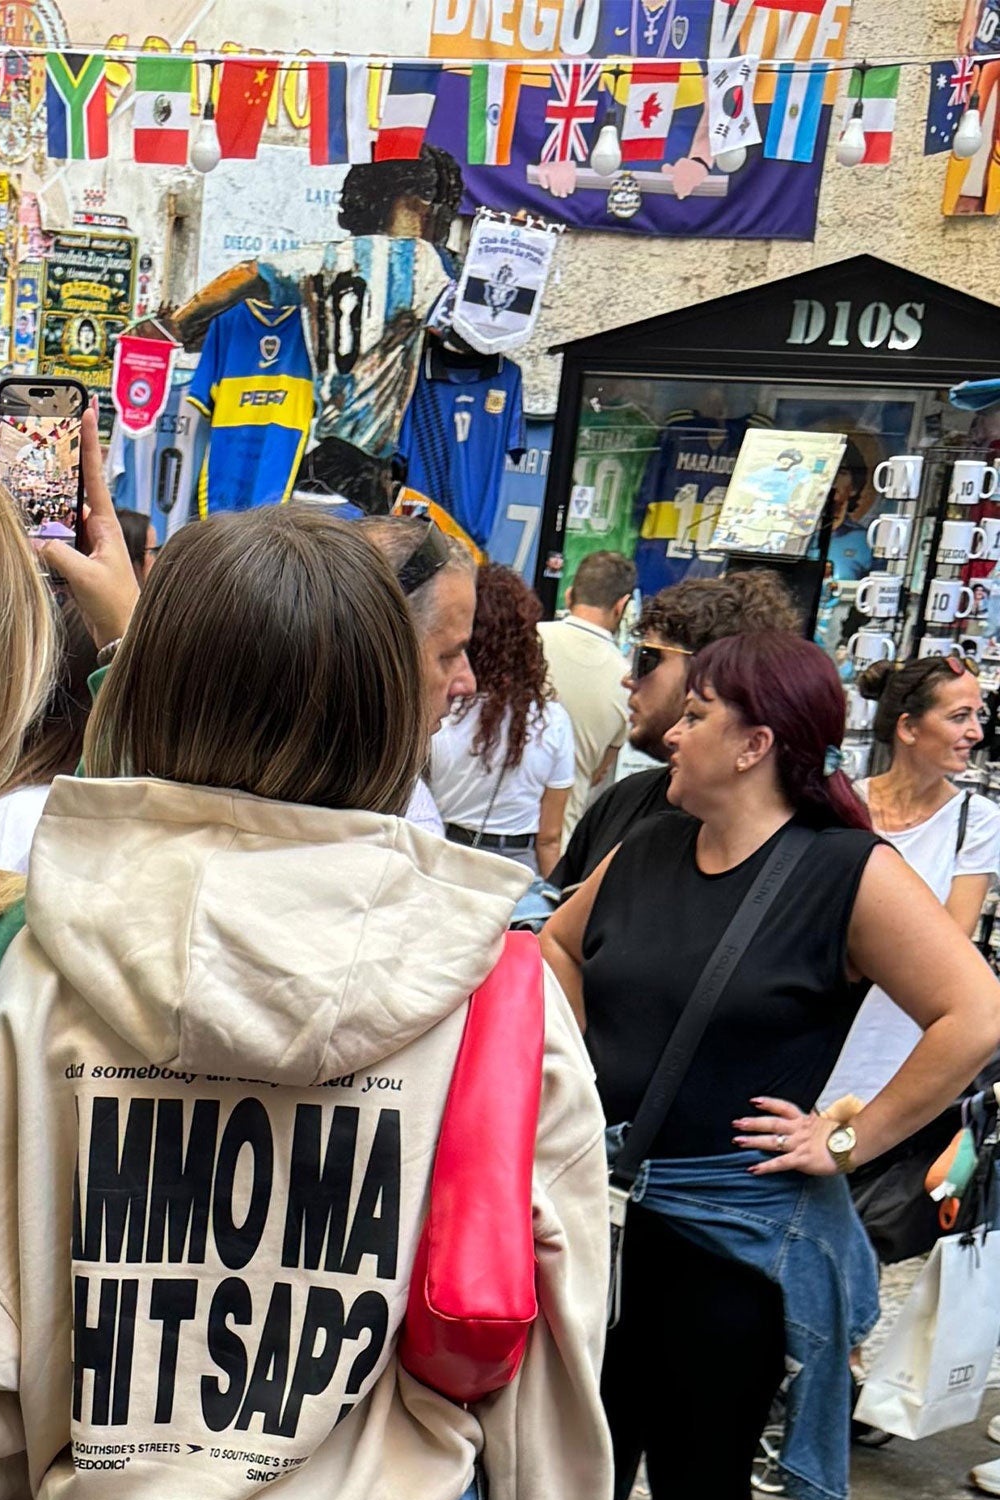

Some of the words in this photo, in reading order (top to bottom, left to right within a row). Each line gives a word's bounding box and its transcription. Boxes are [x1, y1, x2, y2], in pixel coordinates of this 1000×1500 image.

[432, 0, 600, 55] DIEGO
[932, 593, 950, 611] 10
[361, 1076, 404, 1092] you
[72, 1096, 274, 1270] MMO
[281, 1103, 402, 1280] MA
[138, 1442, 181, 1454] STREETS
[210, 1448, 221, 1458] TO
[222, 1449, 280, 1467] SOUTHSIDE'S
